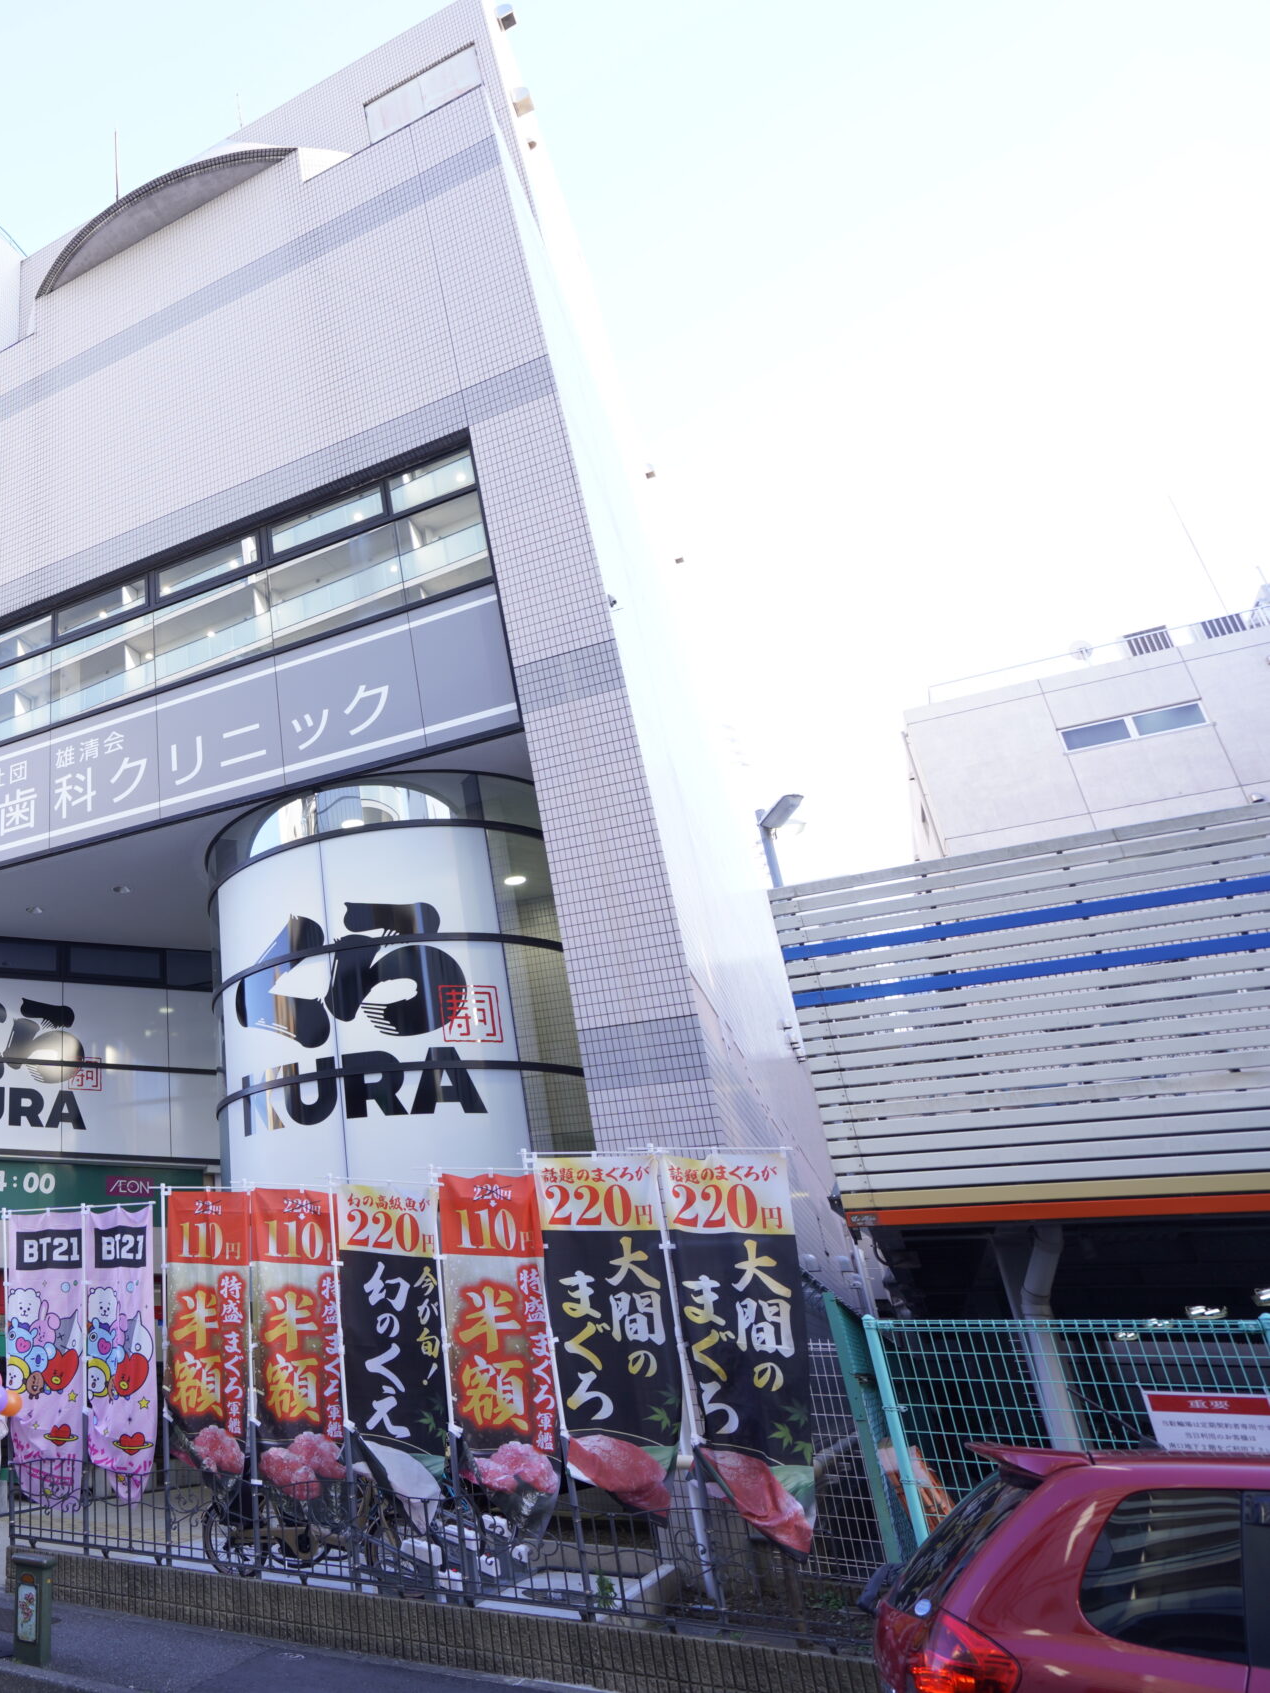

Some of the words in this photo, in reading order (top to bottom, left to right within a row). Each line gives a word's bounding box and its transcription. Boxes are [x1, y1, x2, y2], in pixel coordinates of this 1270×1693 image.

[55, 731, 125, 770] 雄清会
[236, 902, 467, 1049] くら
[241, 1046, 489, 1138] KURA
[348, 1193, 431, 1212] 幻の高級魚が
[541, 1165, 650, 1184] 話題のまぐろが
[545, 1183, 654, 1227] 220円
[668, 1164, 778, 1185] 話題のまぐろが
[672, 1183, 784, 1230] 220円
[23, 1236, 80, 1263] BT21
[101, 1233, 145, 1261] BT21
[264, 1220, 331, 1260] 110
[605, 1236, 666, 1378] 大間の
[731, 1239, 796, 1392] 大間の
[173, 1290, 224, 1418] 半額
[265, 1290, 321, 1423] 半額
[364, 1261, 411, 1439] 幻のくえ
[458, 1286, 529, 1432] 半額
[558, 1270, 614, 1421] まぐろ
[681, 1274, 740, 1435] まぐろ
[1187, 1399, 1230, 1410] 重要
